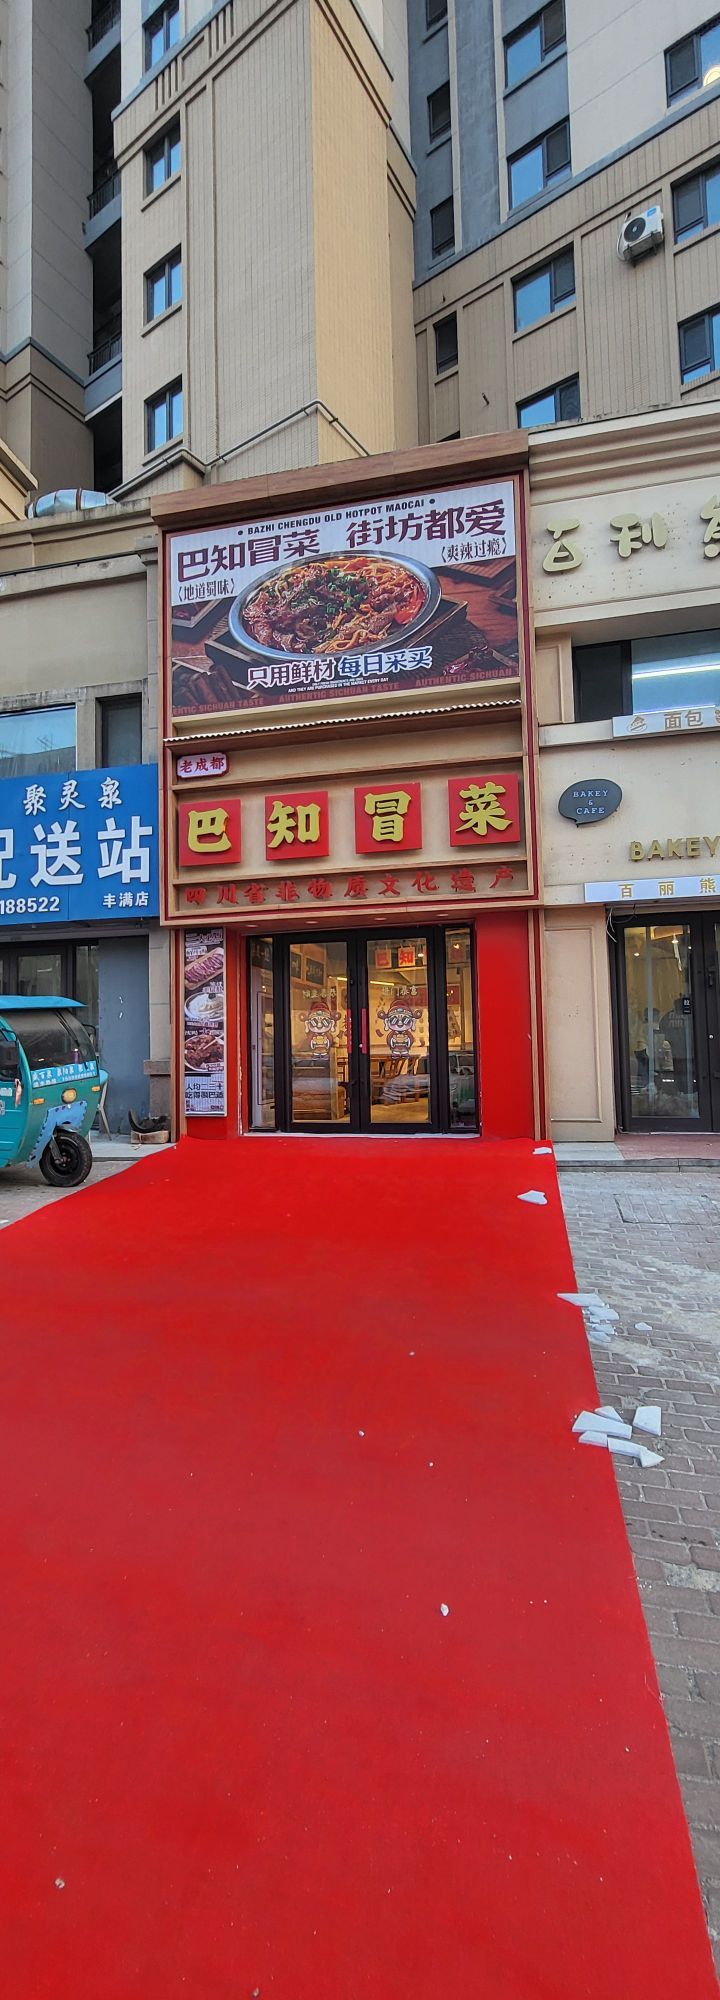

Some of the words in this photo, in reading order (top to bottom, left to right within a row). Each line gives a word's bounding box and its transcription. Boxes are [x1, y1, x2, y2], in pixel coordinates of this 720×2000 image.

[248, 525, 275, 535] BAZHI
[278, 517, 321, 530] CHENGDU
[324, 512, 342, 522] OLD
[346, 506, 383, 519] HOTPOT
[386, 499, 425, 513] MAOCAI
[178, 529, 321, 583] 巴知冒菜
[346, 498, 506, 549] 街坊都爱
[247, 657, 337, 691] 只用鲜材
[338, 645, 433, 678] 每日采买
[415, 673, 469, 687] AUTHENTIC
[470, 668, 513, 681] SICHUAN
[279, 689, 327, 703] AUTHENTIC
[329, 685, 368, 697] SICHUAN
[371, 683, 399, 692] TASTE
[199, 701, 237, 713] SICHUAN
[238, 698, 264, 707] TASTE
[180, 756, 225, 773] 老成都
[23, 777, 123, 816] 聚灵泉
[573, 790, 610, 798] BAKEY
[188, 781, 513, 853] 巴知冒菜
[576, 807, 606, 815] CAFE
[629, 836, 720, 861] BAKEY
[184, 865, 514, 905] 四川省非物质文化遗产
[618, 878, 716, 898] 百丽熊
[103, 891, 149, 908] 丰满店
